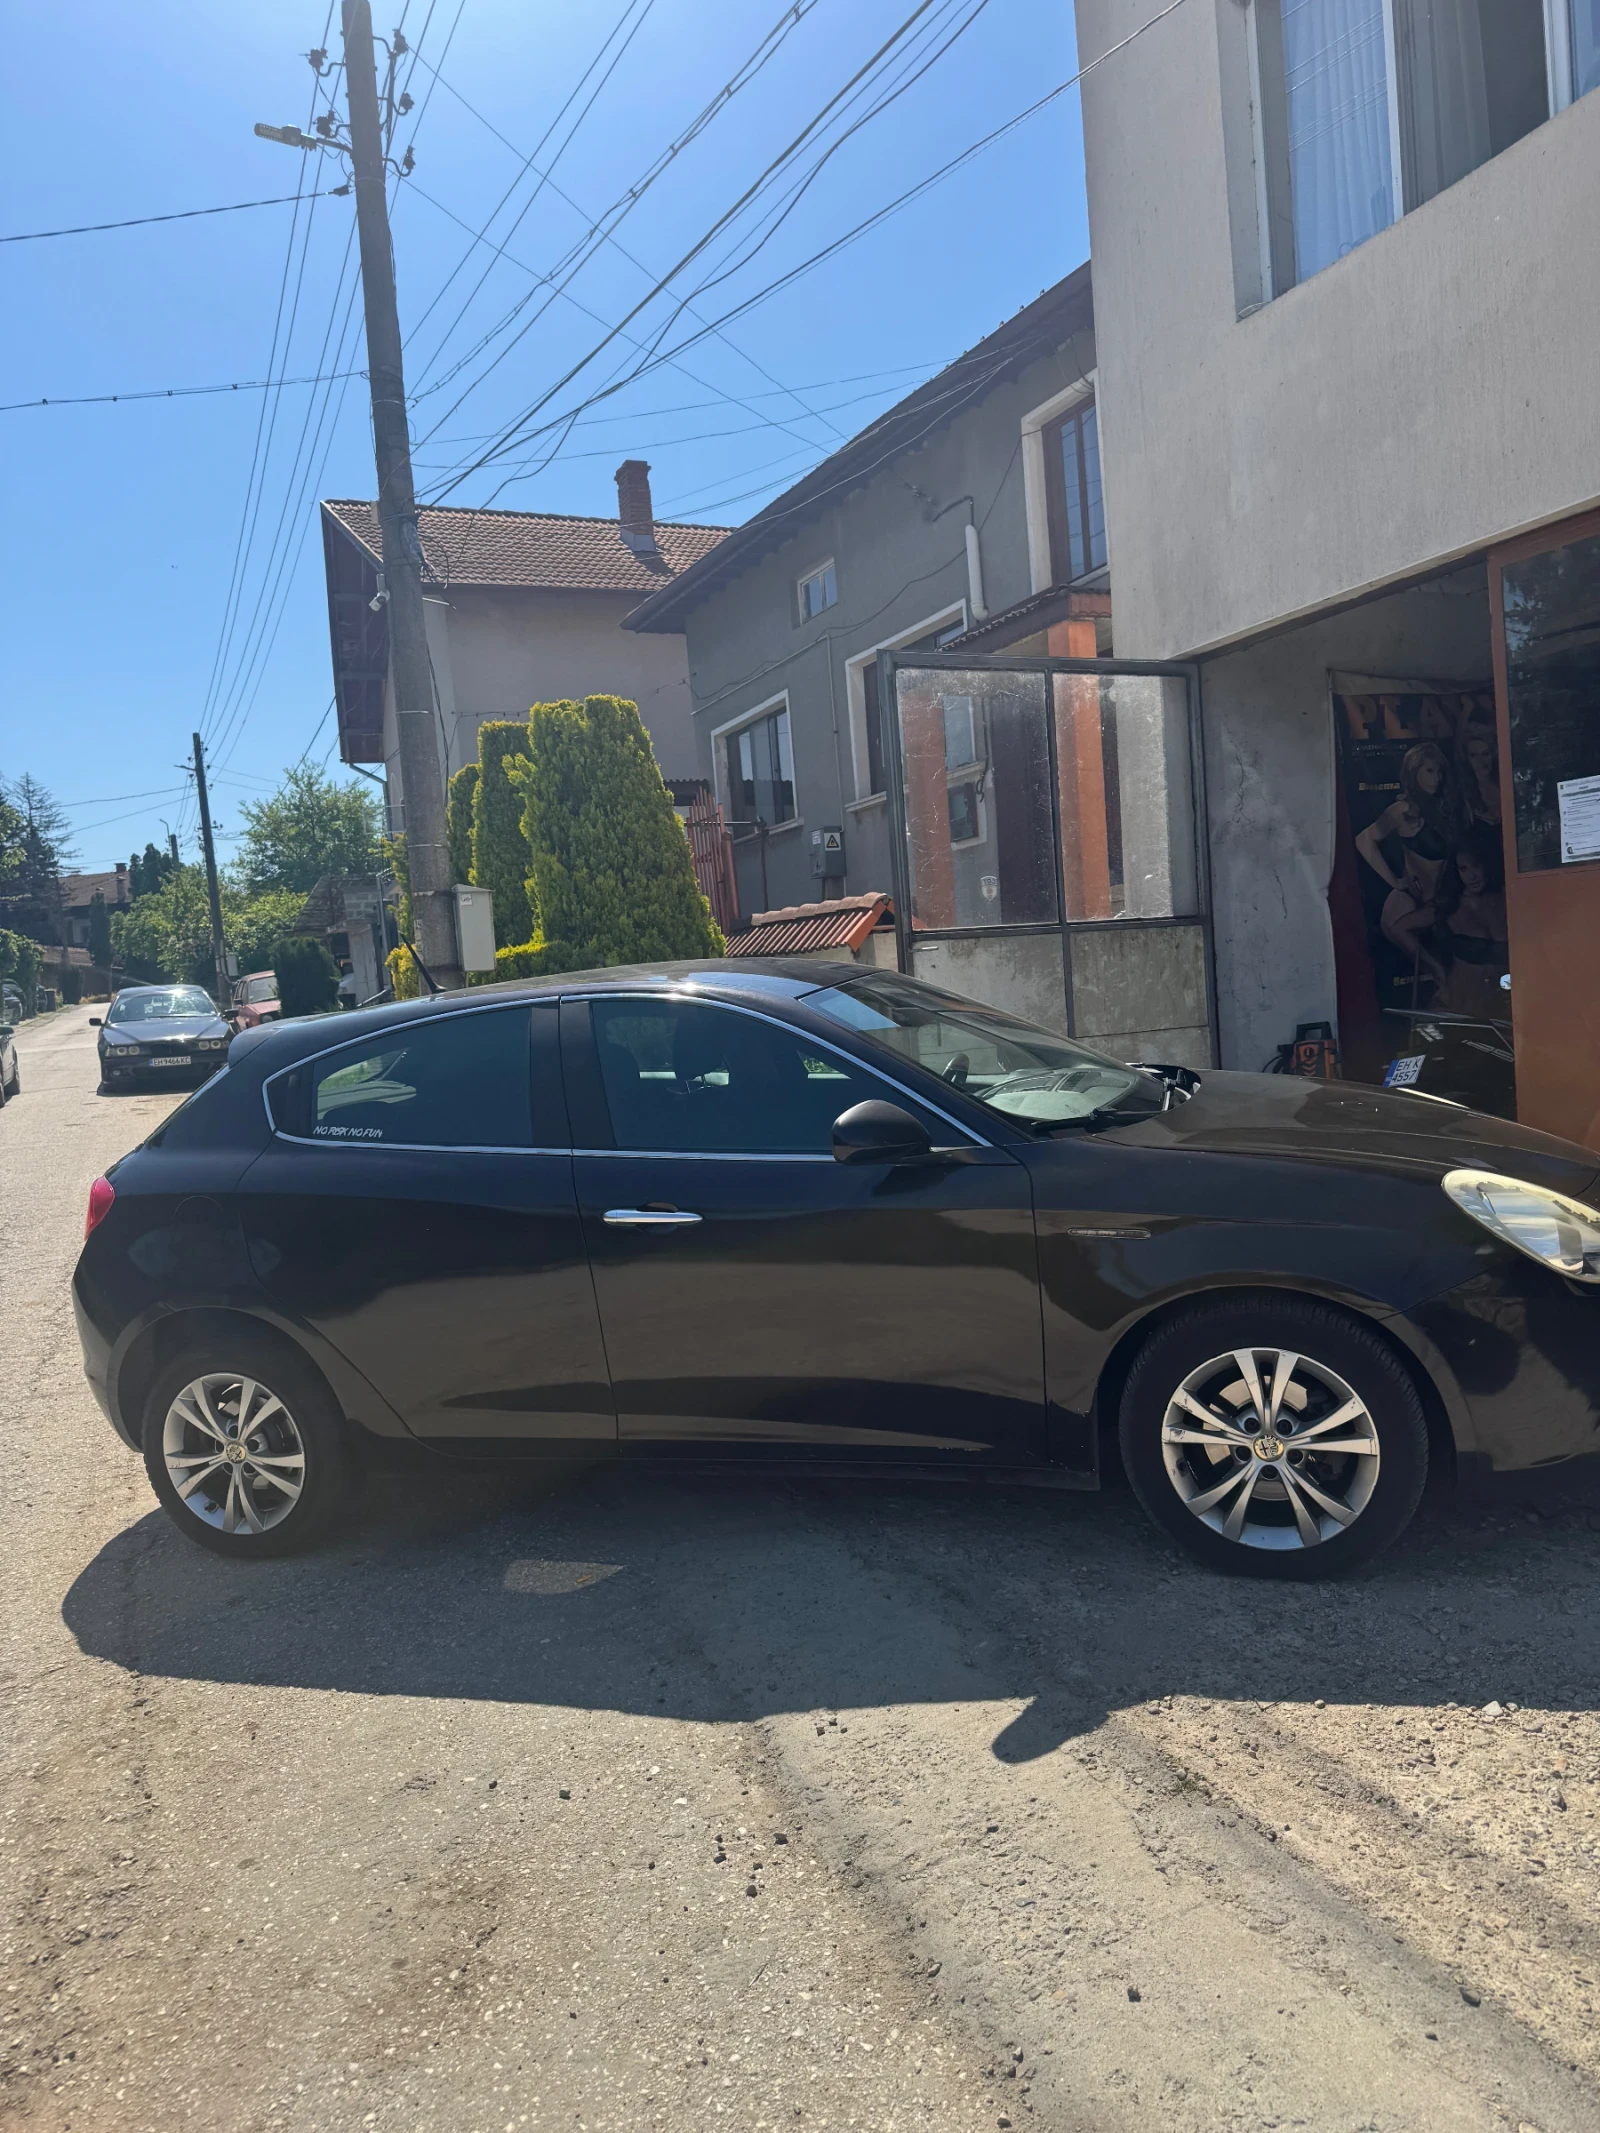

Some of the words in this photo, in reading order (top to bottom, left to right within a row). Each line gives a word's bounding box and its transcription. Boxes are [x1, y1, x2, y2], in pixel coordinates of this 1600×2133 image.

[1392, 1069, 1417, 1082] 4557
[313, 1126, 328, 1135] NO
[348, 1127, 363, 1137] NO
[362, 1128, 383, 1138] FUN
